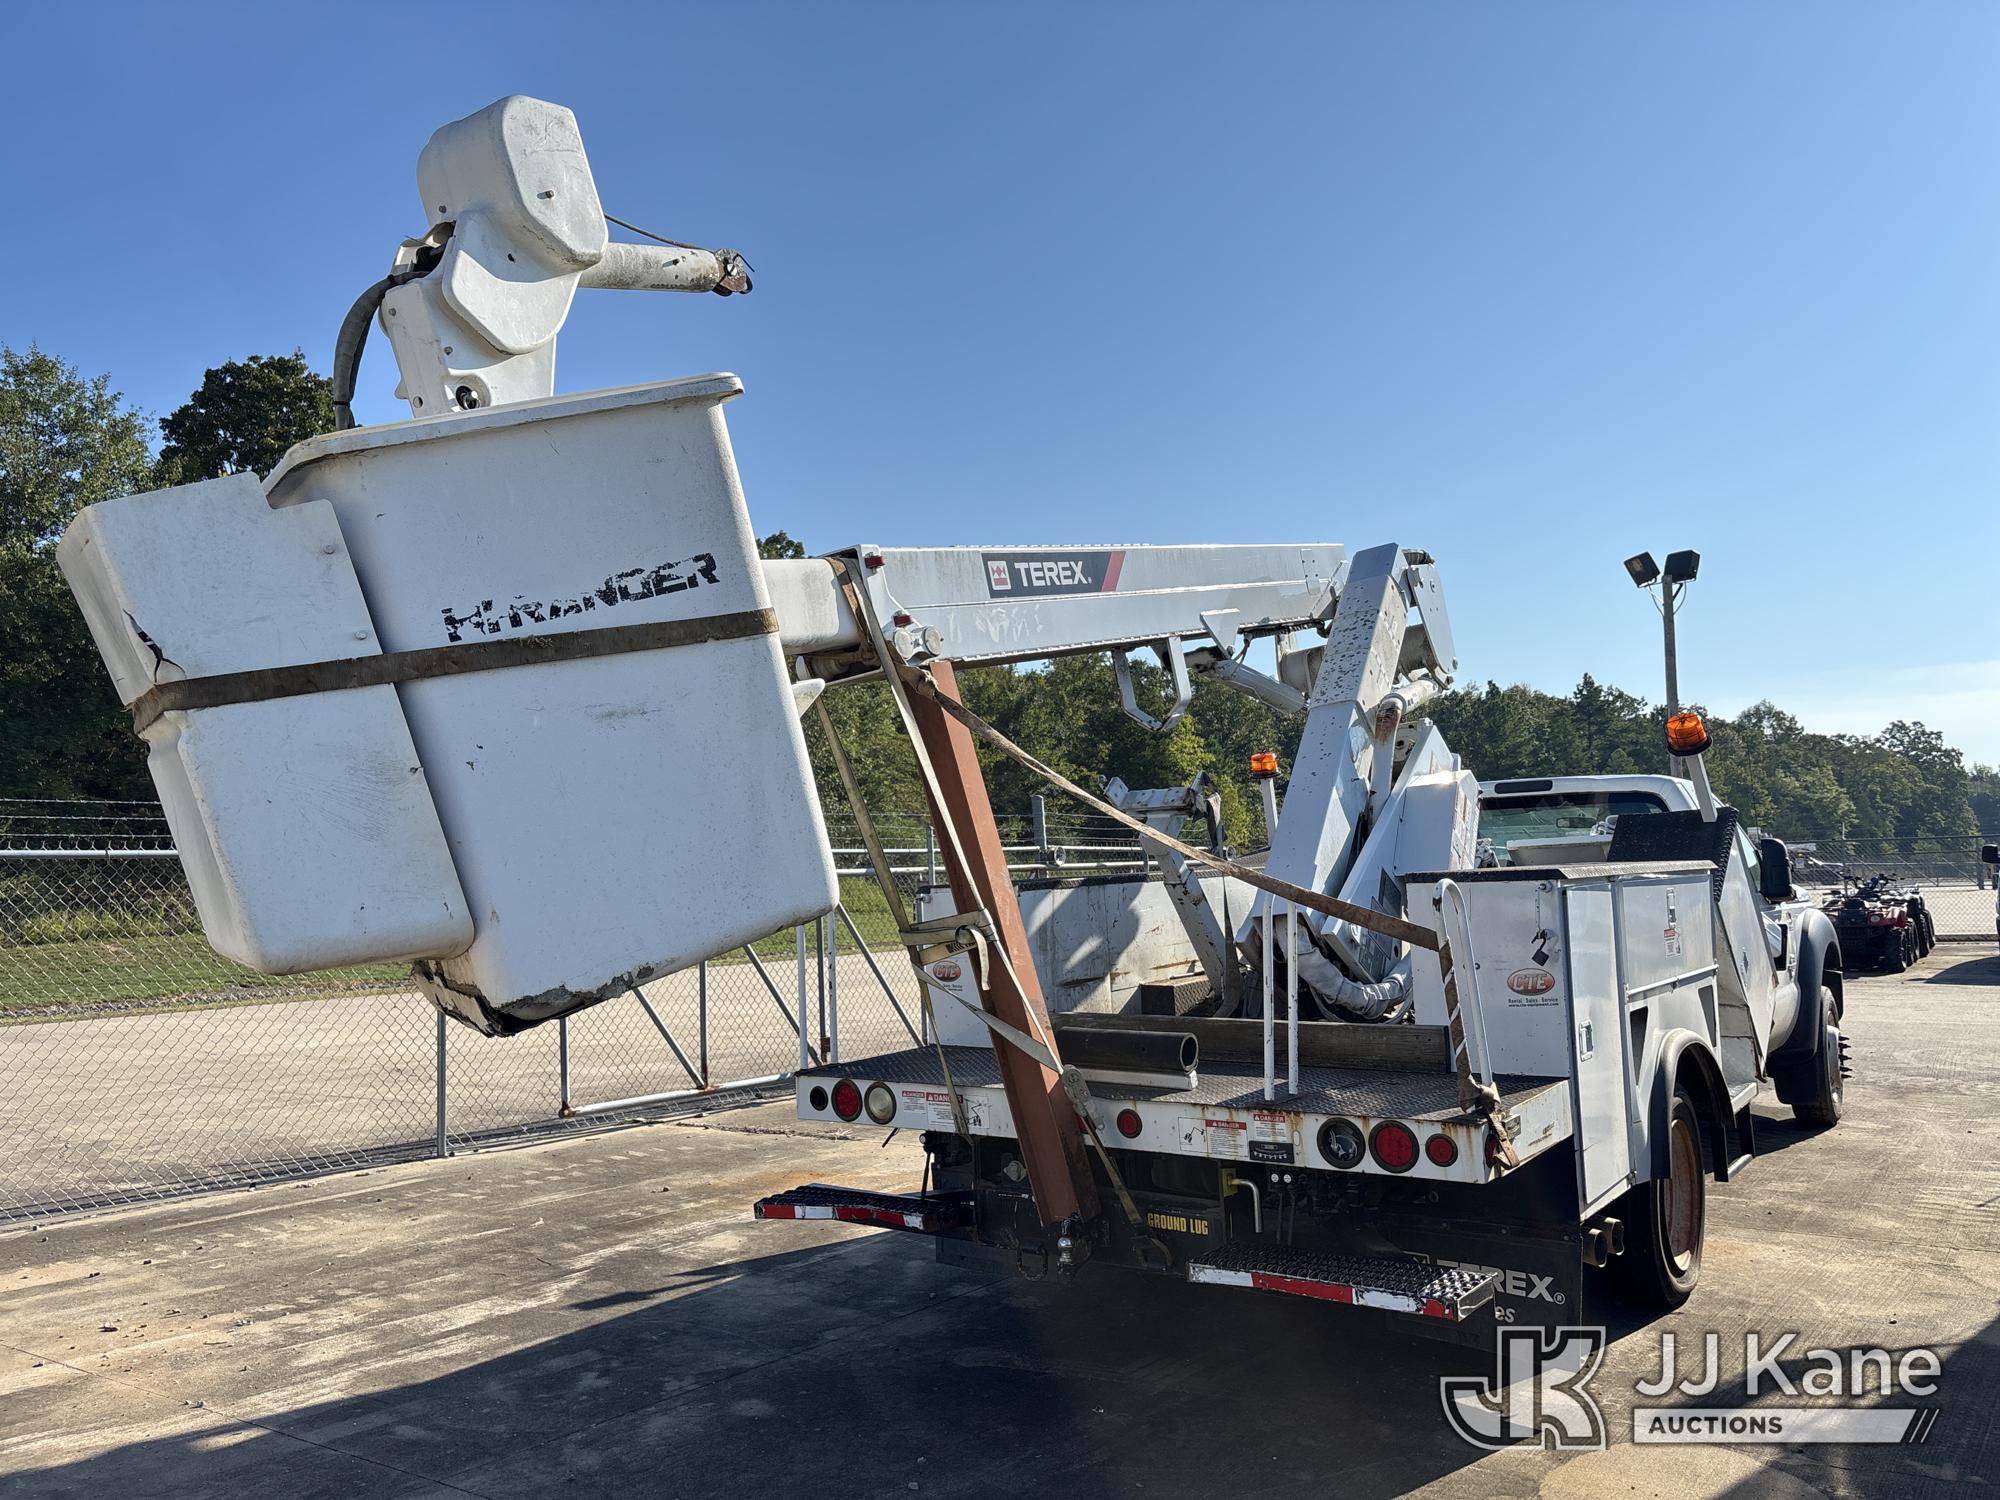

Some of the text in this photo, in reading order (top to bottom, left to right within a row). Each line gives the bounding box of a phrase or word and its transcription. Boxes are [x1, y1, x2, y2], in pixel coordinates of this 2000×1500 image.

[1513, 975, 1547, 990] CTE
[1147, 1212, 1187, 1232] GROUND
[1190, 1218, 1209, 1235] LUG
